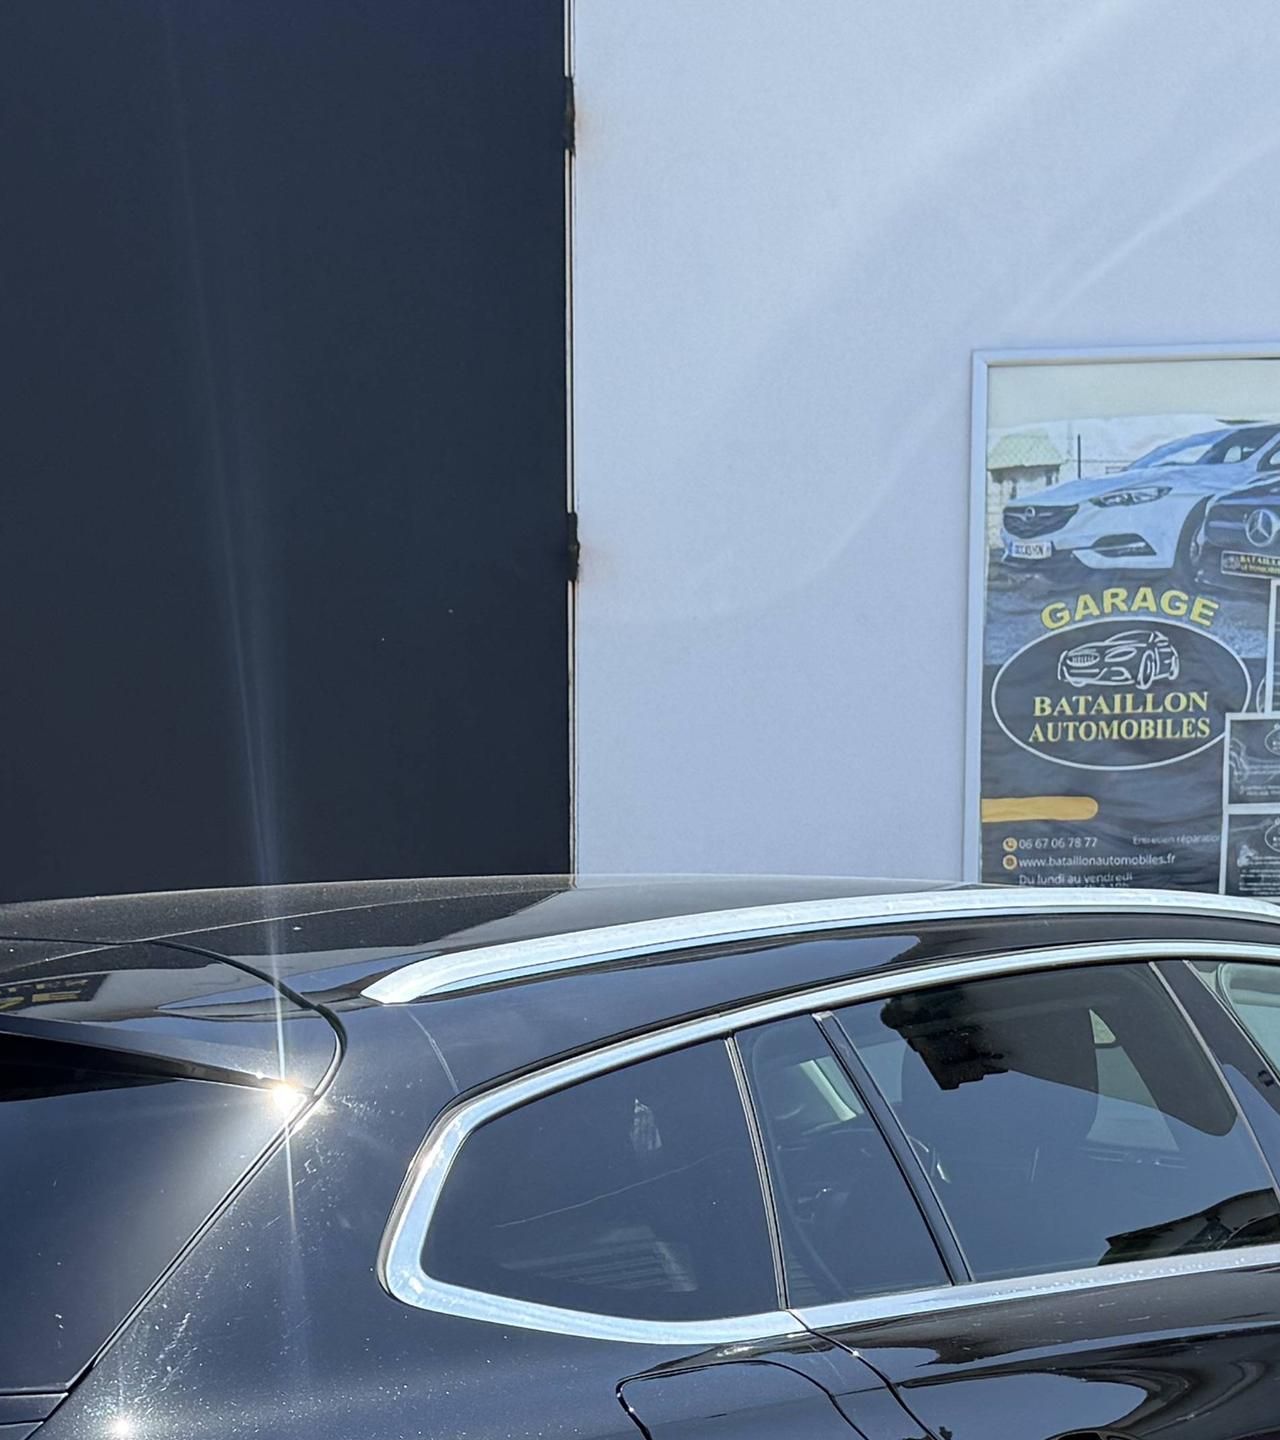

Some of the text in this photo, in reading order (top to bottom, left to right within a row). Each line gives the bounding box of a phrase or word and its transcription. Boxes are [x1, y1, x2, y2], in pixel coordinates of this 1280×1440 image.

[1040, 586, 1219, 630] GARAGE
[1032, 691, 1209, 718] BATAILLON
[1028, 716, 1211, 743] AUTOMOBILES
[1018, 836, 1098, 849] 06 67 06 78 77
[1019, 852, 1176, 867] www.bataillonautomobiles.fr
[1037, 873, 1065, 885] lundi
[1066, 875, 1081, 884] au
[1083, 872, 1133, 884] vendredi
